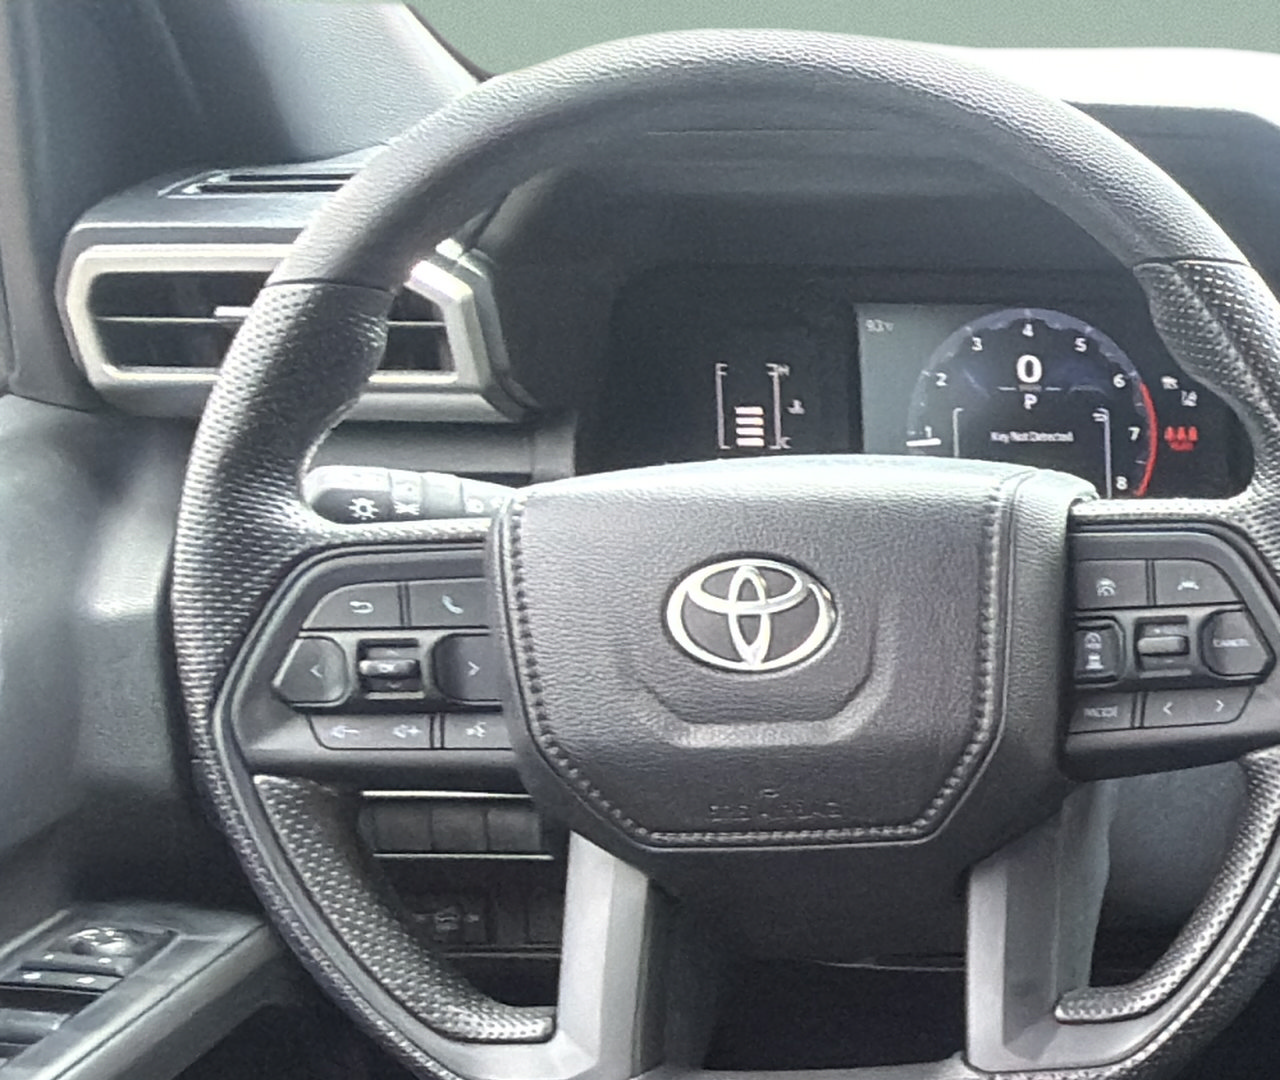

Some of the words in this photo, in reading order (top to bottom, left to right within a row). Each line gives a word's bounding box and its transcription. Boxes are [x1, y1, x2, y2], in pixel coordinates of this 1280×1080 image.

[1022, 324, 1034, 337] 4
[972, 337, 983, 351] 3
[1074, 338, 1087, 352] 5
[1016, 354, 1043, 384] 0
[936, 372, 947, 386] 2
[1113, 373, 1126, 388] 6
[1023, 393, 1038, 410] P
[924, 426, 933, 438] 1
[1128, 426, 1141, 441] 7
[1115, 476, 1129, 490] 8
